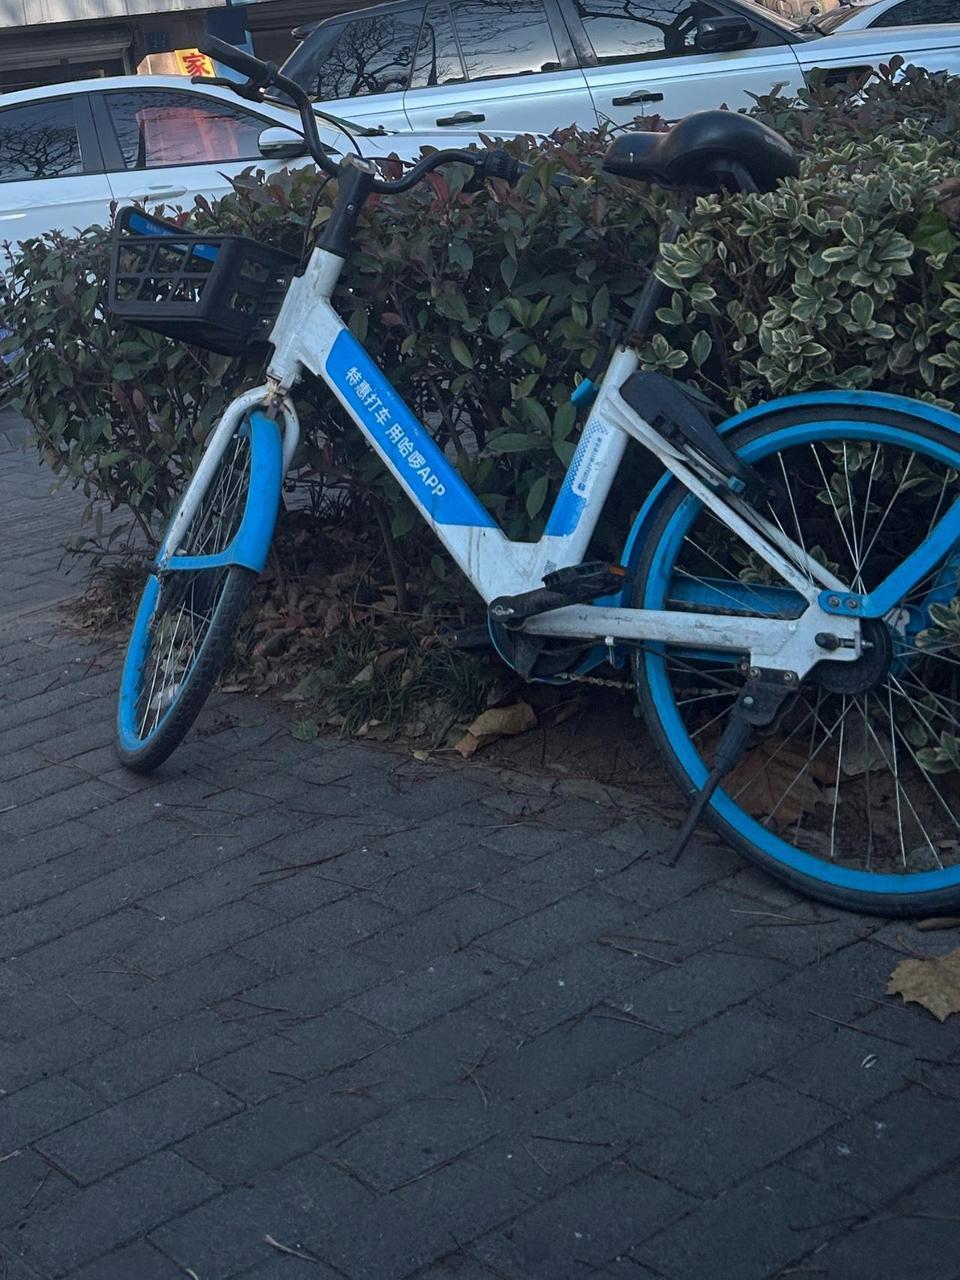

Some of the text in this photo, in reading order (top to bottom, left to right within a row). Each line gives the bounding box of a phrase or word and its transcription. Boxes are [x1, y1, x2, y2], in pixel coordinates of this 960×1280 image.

[182, 53, 211, 77] 家
[344, 366, 447, 498] 特惠打车 用哈啰APP
